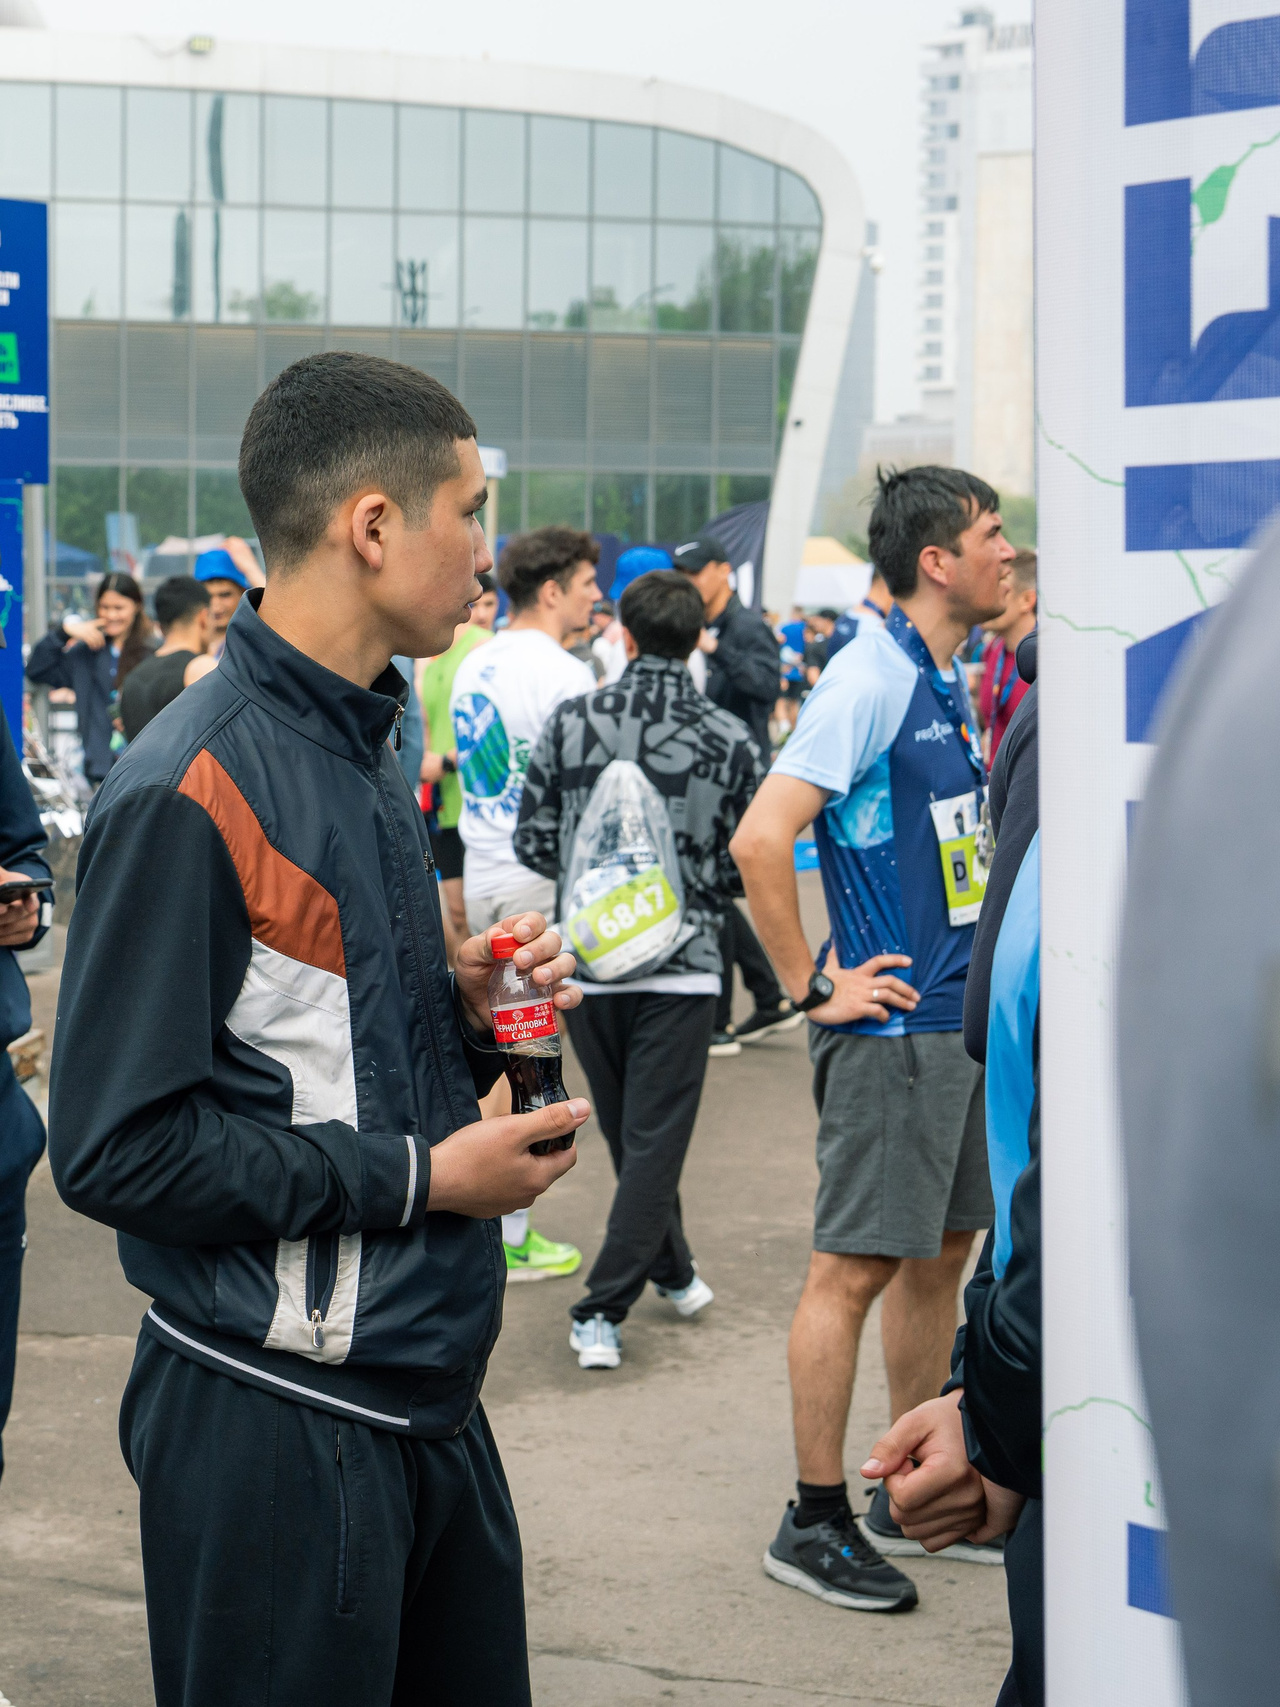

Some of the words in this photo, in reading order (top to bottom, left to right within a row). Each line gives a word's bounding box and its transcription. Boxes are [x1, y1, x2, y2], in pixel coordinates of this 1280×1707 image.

[953, 860, 968, 882] D
[597, 882, 666, 939] 6847
[496, 1017, 548, 1033] ЧЕРНОГОЛОВКА
[511, 1030, 533, 1040] Cola
